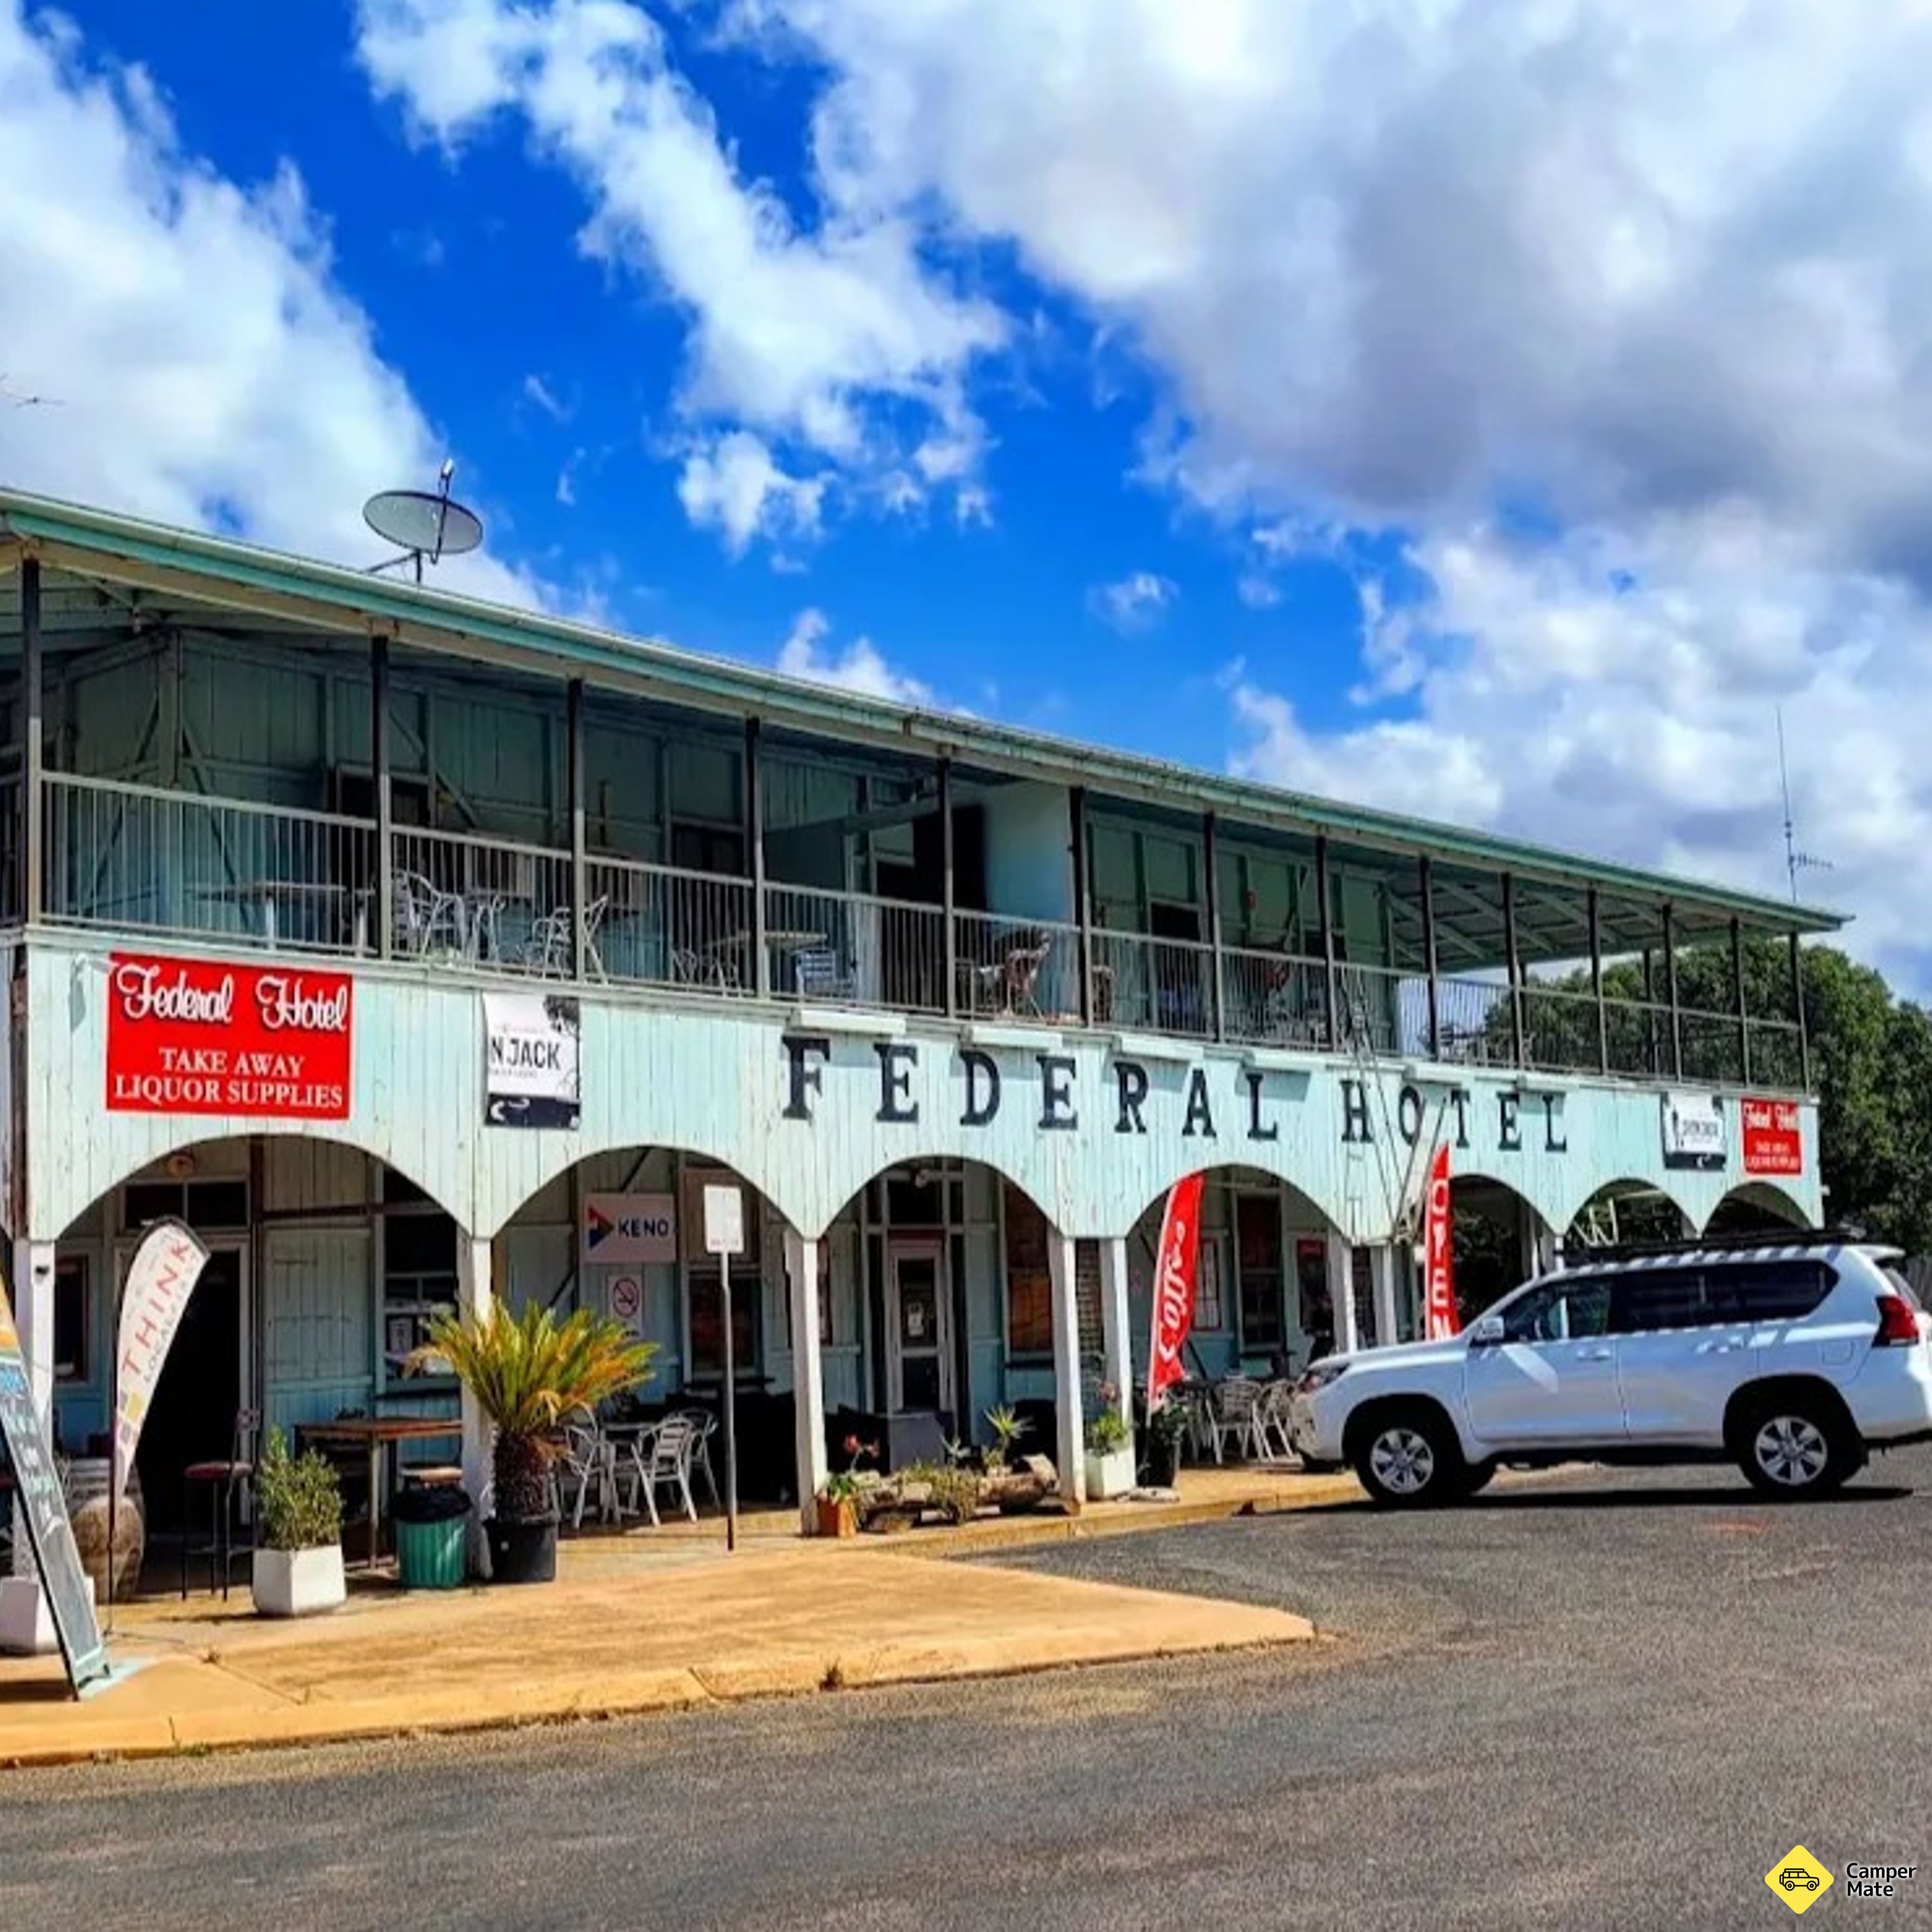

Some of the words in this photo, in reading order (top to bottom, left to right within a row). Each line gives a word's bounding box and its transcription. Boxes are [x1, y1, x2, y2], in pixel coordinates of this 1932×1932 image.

[116, 963, 234, 1023] Federal
[256, 976, 347, 1032] Hotel
[159, 1048, 227, 1073] TAKE
[235, 1053, 305, 1078] AWAY
[507, 1038, 561, 1070] JACK
[115, 1075, 220, 1105] LIQUOR
[227, 1083, 342, 1108] SUPPLIES
[781, 1035, 1278, 1140] FEDERAL
[1340, 1080, 1567, 1152] HOTEL
[619, 1218, 669, 1238] KENO
[122, 1240, 189, 1375] THINK
